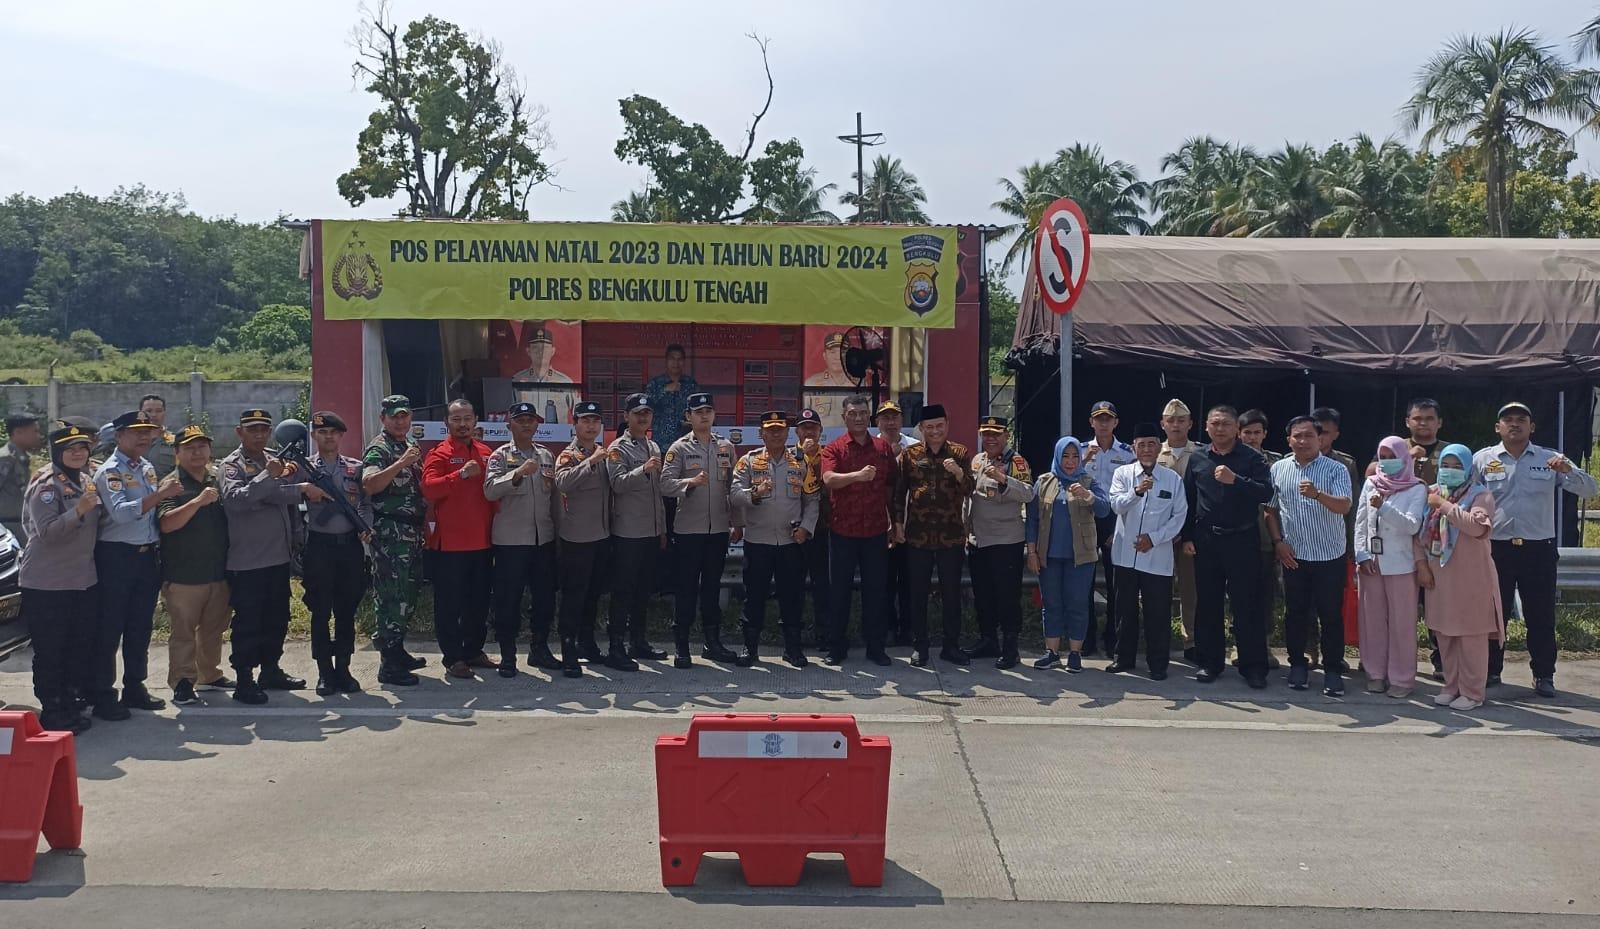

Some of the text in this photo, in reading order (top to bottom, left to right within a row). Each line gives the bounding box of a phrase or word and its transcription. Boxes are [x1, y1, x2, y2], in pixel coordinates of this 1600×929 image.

[390, 239, 888, 270] POS PELAYANAN NATAL 2023 DAN TAHUN BARU 2024
[509, 277, 768, 305] POLRES BENGKULU TENGAH
